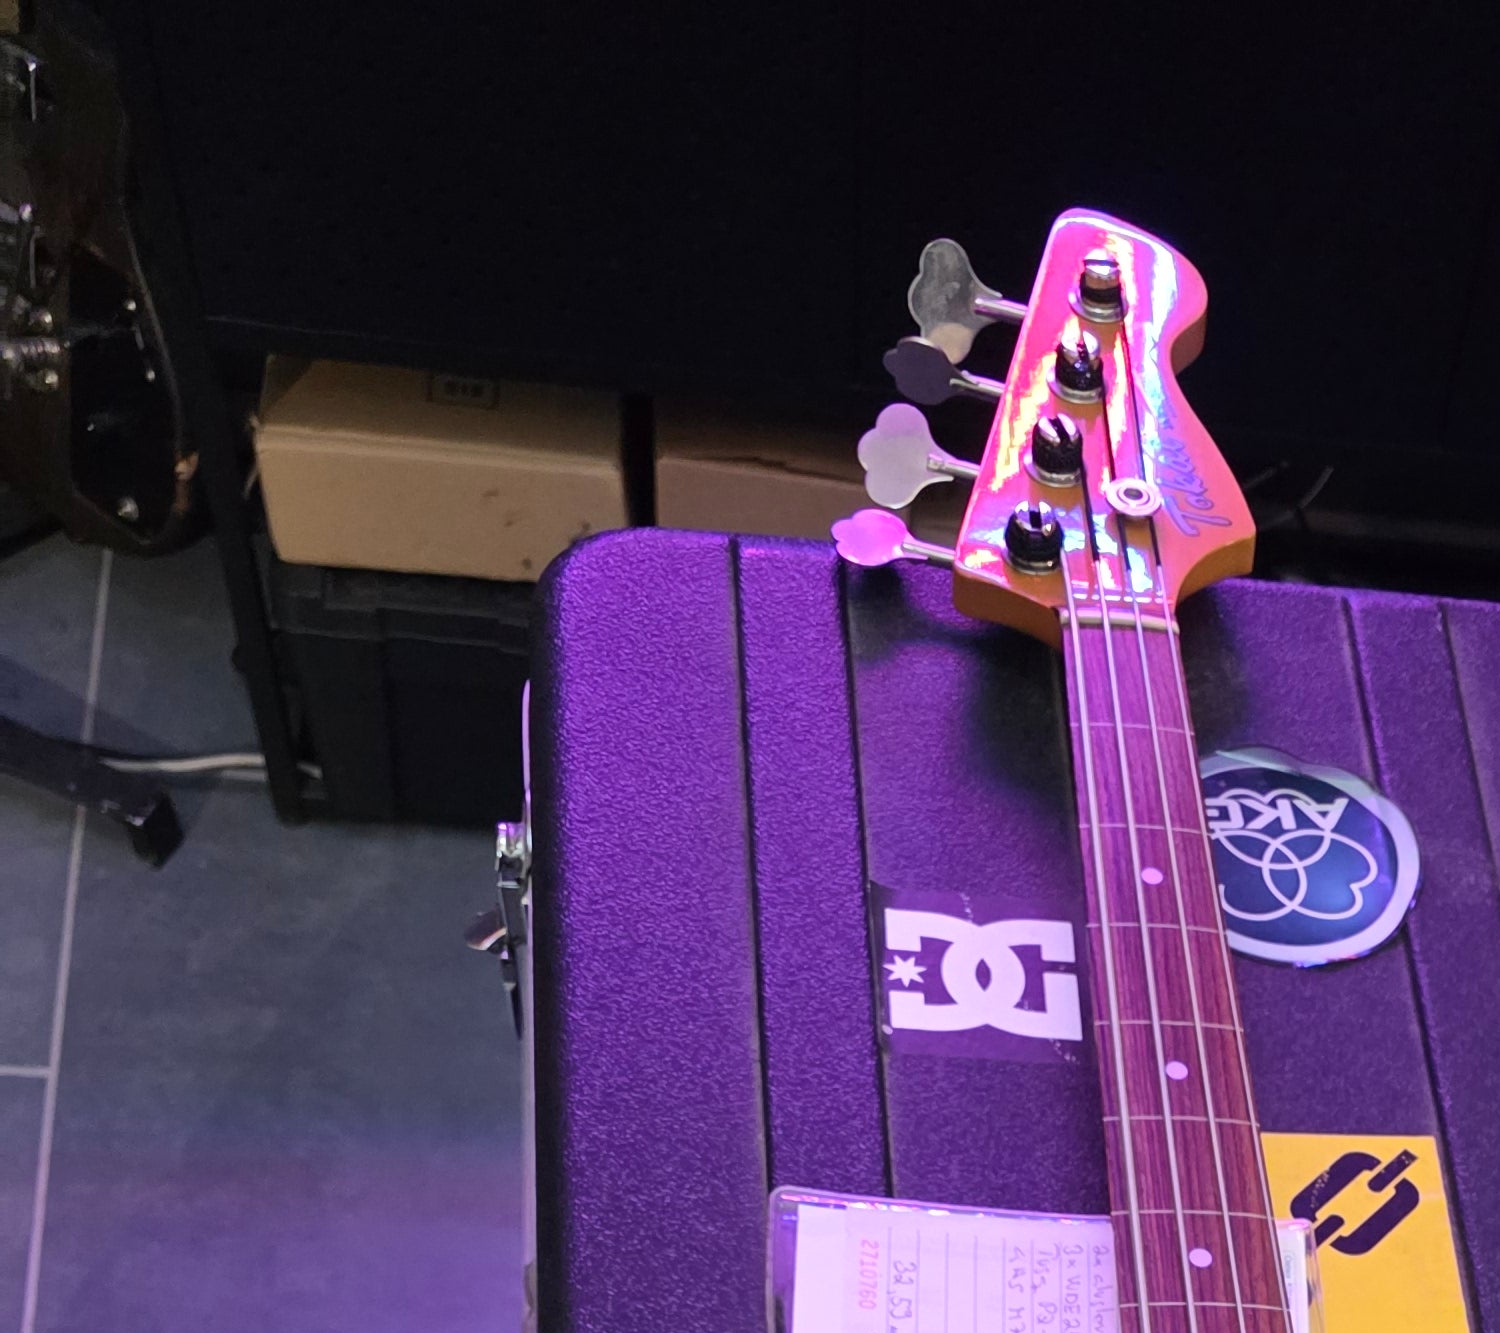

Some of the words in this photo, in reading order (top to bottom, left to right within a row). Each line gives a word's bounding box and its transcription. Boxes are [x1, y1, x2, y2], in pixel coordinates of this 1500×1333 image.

[1156, 436, 1233, 537] Tokai
[1204, 797, 1350, 830] AKG
[859, 1239, 880, 1310] 2710760
